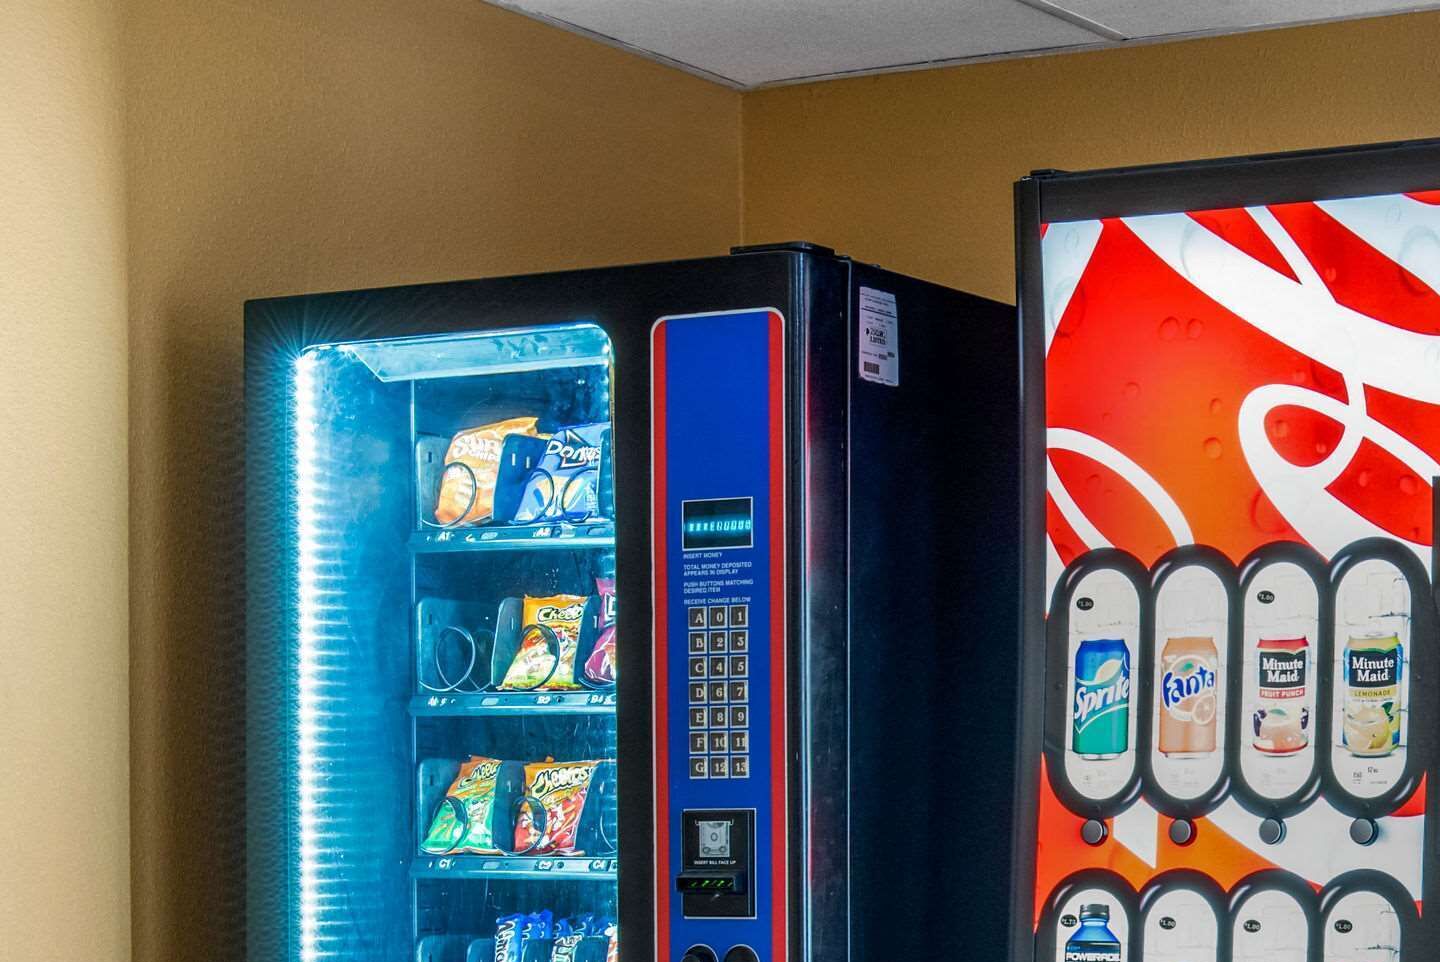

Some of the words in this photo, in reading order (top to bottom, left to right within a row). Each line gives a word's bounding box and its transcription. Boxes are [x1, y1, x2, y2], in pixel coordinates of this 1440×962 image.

[696, 614, 704, 623] A
[716, 612, 723, 622] 0
[696, 638, 704, 648] B
[716, 637, 724, 648] 2
[737, 636, 744, 646] 3
[696, 663, 704, 673] C
[716, 662, 723, 672] 4
[737, 662, 744, 672] 5
[1262, 657, 1304, 670] Minute
[1352, 656, 1394, 670] Minute
[1267, 670, 1299, 682] Maid
[1357, 669, 1389, 682] Maid
[1162, 664, 1215, 708] Fanta
[696, 688, 704, 698] D
[716, 687, 723, 697] 6
[736, 687, 744, 696] 7
[1074, 671, 1129, 722] Sprite
[1261, 689, 1281, 698] FRUIT
[1284, 688, 1304, 696] PUNCH
[696, 713, 704, 723] E
[716, 712, 723, 722] 8
[738, 712, 744, 722] 9
[696, 738, 704, 748] F
[715, 738, 726, 748] 10
[736, 738, 746, 747] 11
[696, 762, 704, 773] G
[715, 762, 726, 772] 12
[736, 762, 746, 772] 13
[1066, 952, 1120, 962] POWERADE
